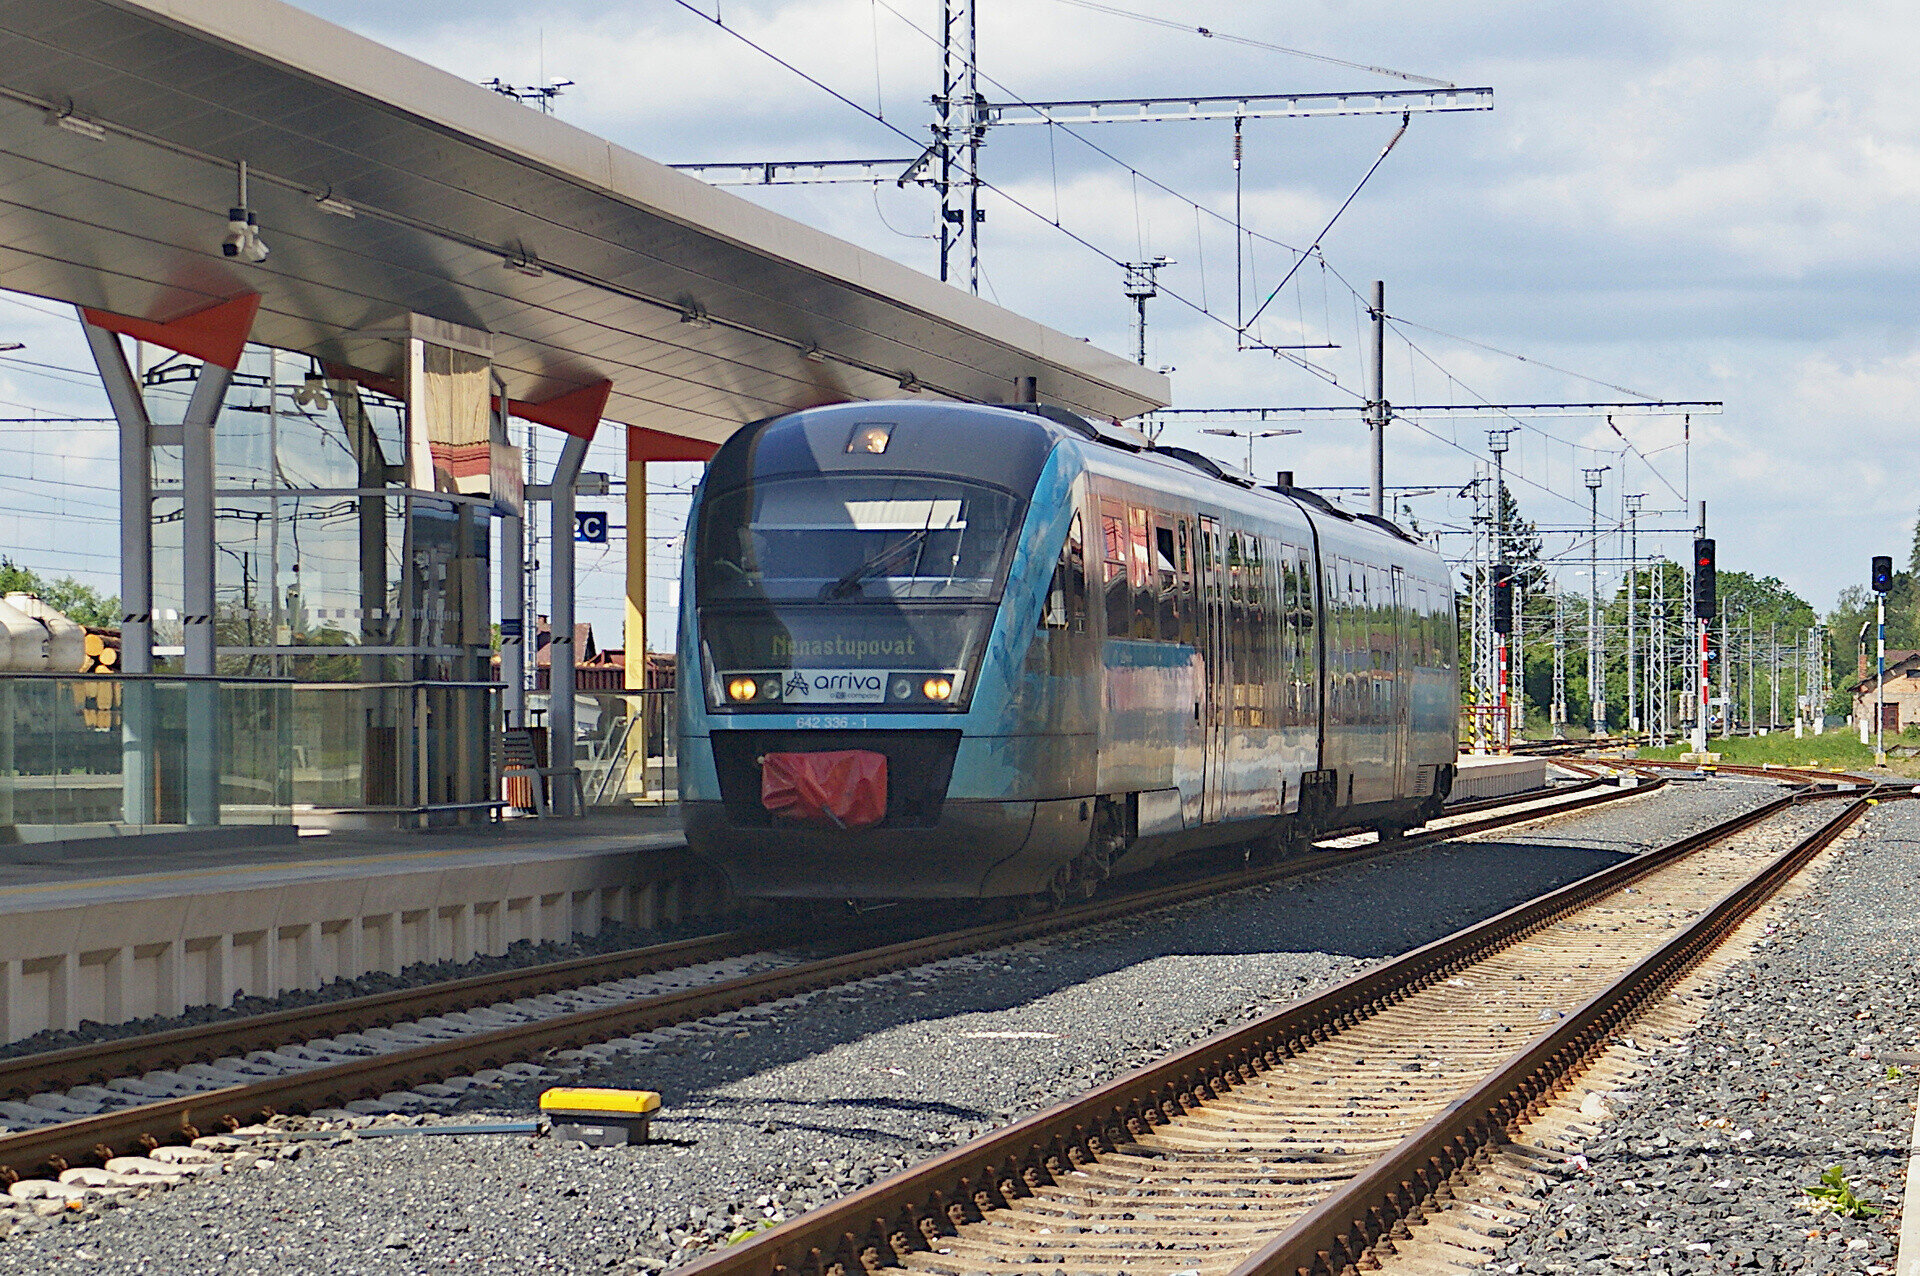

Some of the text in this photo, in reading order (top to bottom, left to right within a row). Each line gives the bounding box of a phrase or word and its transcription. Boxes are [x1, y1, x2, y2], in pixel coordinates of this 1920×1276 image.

[772, 634, 915, 660] Nenastupovat
[814, 672, 881, 690] arriva
[796, 717, 820, 729] 642
[824, 717, 848, 729] 336
